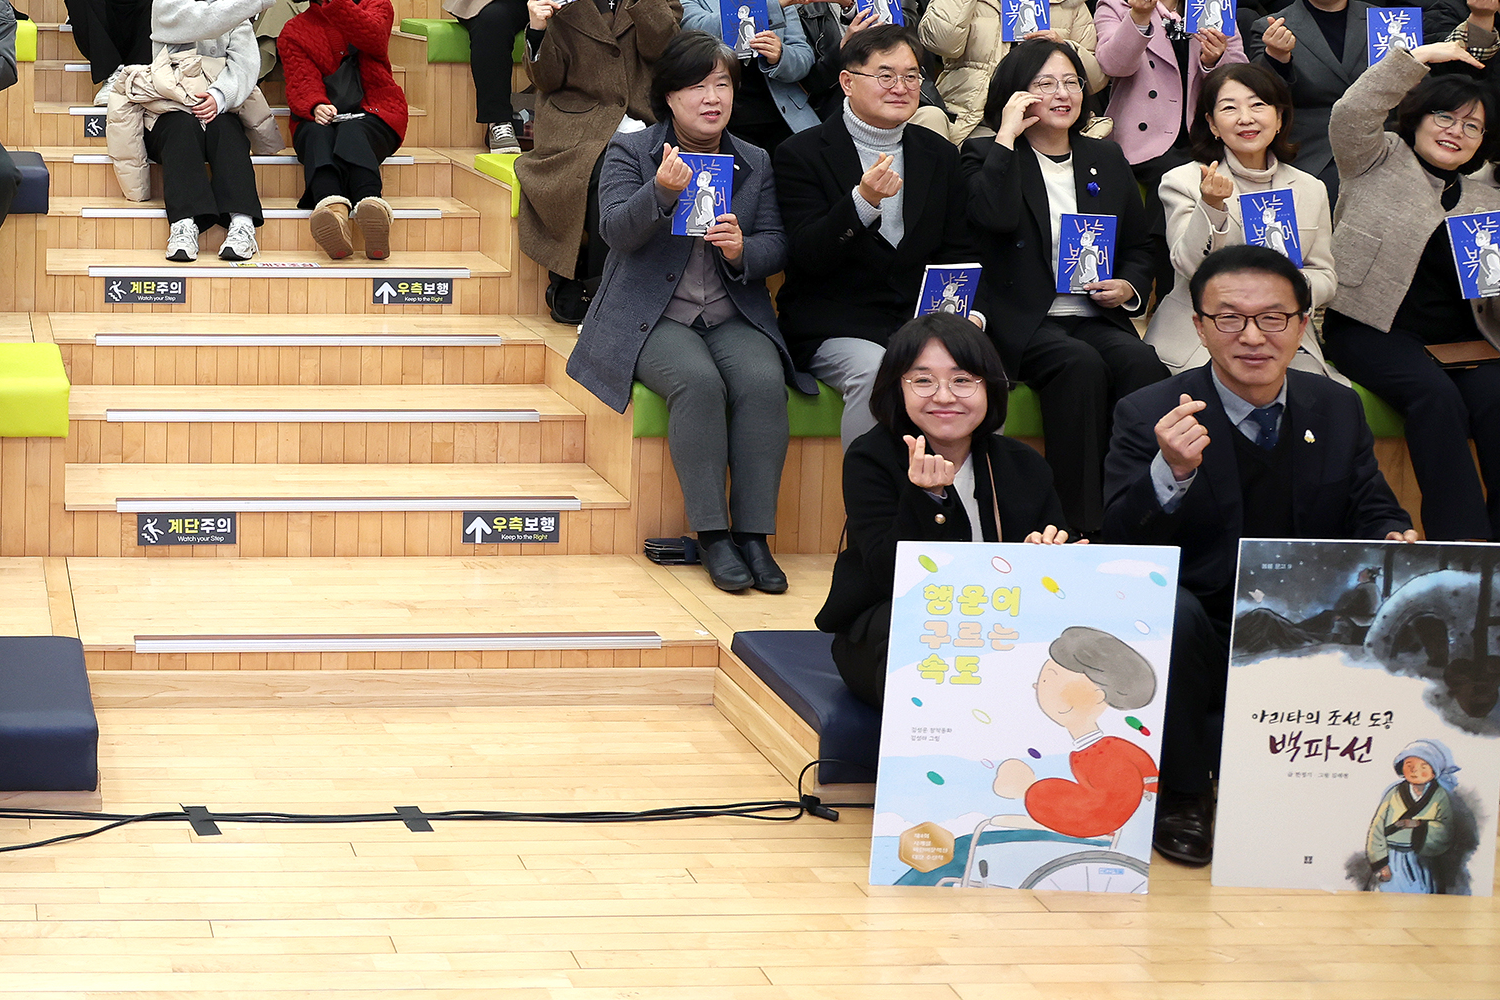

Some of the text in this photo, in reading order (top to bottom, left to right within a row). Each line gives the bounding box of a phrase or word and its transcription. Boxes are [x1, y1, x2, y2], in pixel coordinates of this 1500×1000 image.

[1006, 0, 1047, 26] 복어
[1379, 10, 1411, 26] 나는
[689, 158, 722, 176] 나는
[1250, 194, 1284, 212] 나는
[1073, 219, 1106, 236] 나는
[1462, 216, 1499, 235] 나는
[1063, 243, 1110, 275] 복어
[129, 281, 182, 295] 계단주의
[939, 271, 969, 287] 나는
[397, 282, 449, 295] 우측보행
[168, 518, 231, 534] 계단주의
[492, 516, 554, 532] 우측보행
[198, 536, 211, 544] your
[211, 536, 224, 544] Step
[501, 534, 515, 542] Keep
[533, 534, 548, 542] Right
[922, 583, 1021, 617] 행운이
[920, 620, 1020, 651] 구르는
[917, 653, 982, 685] 속도
[1251, 710, 1394, 730] 아리타의 조선 도공
[1269, 731, 1373, 763] 백파선
